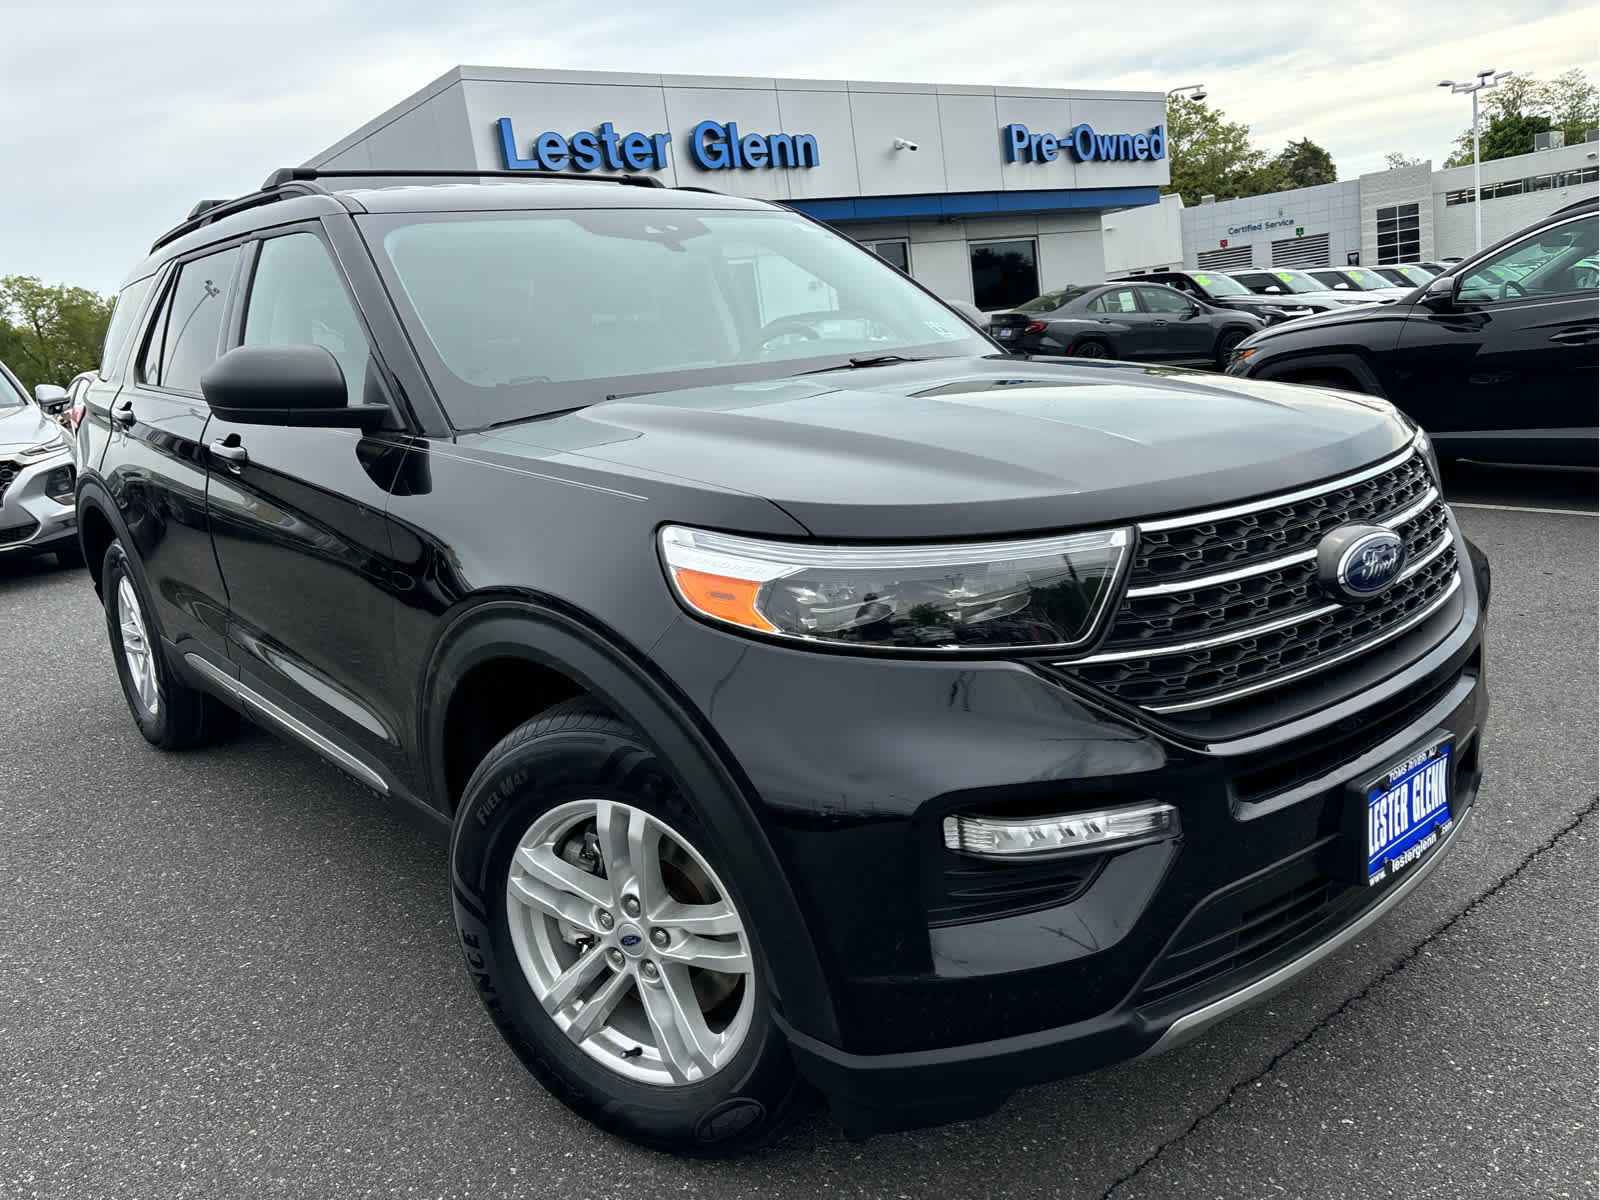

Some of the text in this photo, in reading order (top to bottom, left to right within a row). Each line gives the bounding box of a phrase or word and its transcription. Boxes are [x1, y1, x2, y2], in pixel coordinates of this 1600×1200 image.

[496, 117, 820, 171] Lester Glenn
[1005, 123, 1166, 163] Pre-Owned
[1228, 218, 1295, 235] Certified Service
[1368, 757, 1447, 857] LESTER GLENN
[1391, 832, 1437, 873] lesterglenn
